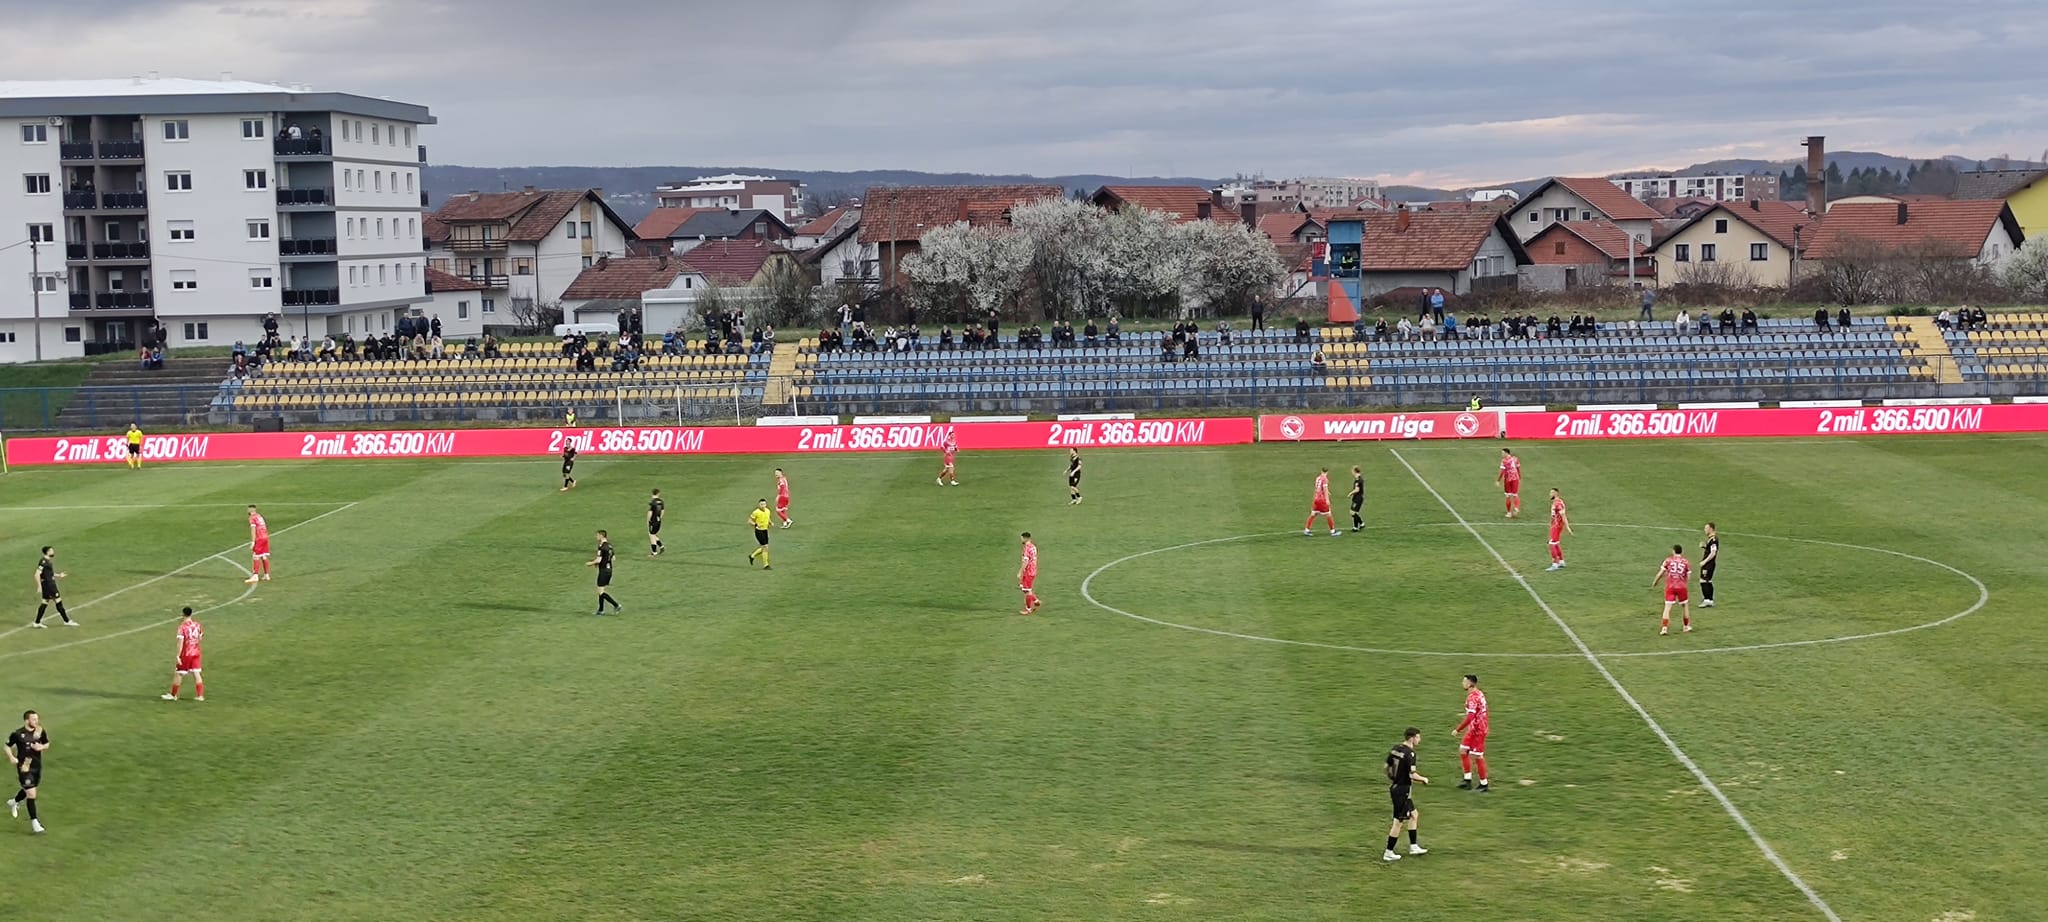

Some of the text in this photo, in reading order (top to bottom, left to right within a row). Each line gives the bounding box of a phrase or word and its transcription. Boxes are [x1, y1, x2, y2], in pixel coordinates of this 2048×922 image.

[1323, 420, 1386, 435] wwin
[1390, 415, 1435, 437] liga
[1555, 412, 1718, 436] 2 mil. 366.500 KM
[1817, 408, 1983, 432] 2 mil. 366.500 KM
[301, 433, 455, 455] 2 mil. 366.500 KM
[548, 431, 563, 452] 2
[598, 430, 673, 451] 366.500
[674, 430, 704, 450] KM
[798, 428, 813, 449] 2
[812, 428, 844, 449] mil.
[848, 427, 923, 448] 366.500
[1048, 421, 1205, 445] 2 mil. 366.500 KM
[54, 437, 208, 461] 2 mil. 36.500 KM
[1670, 561, 1686, 574] 35
